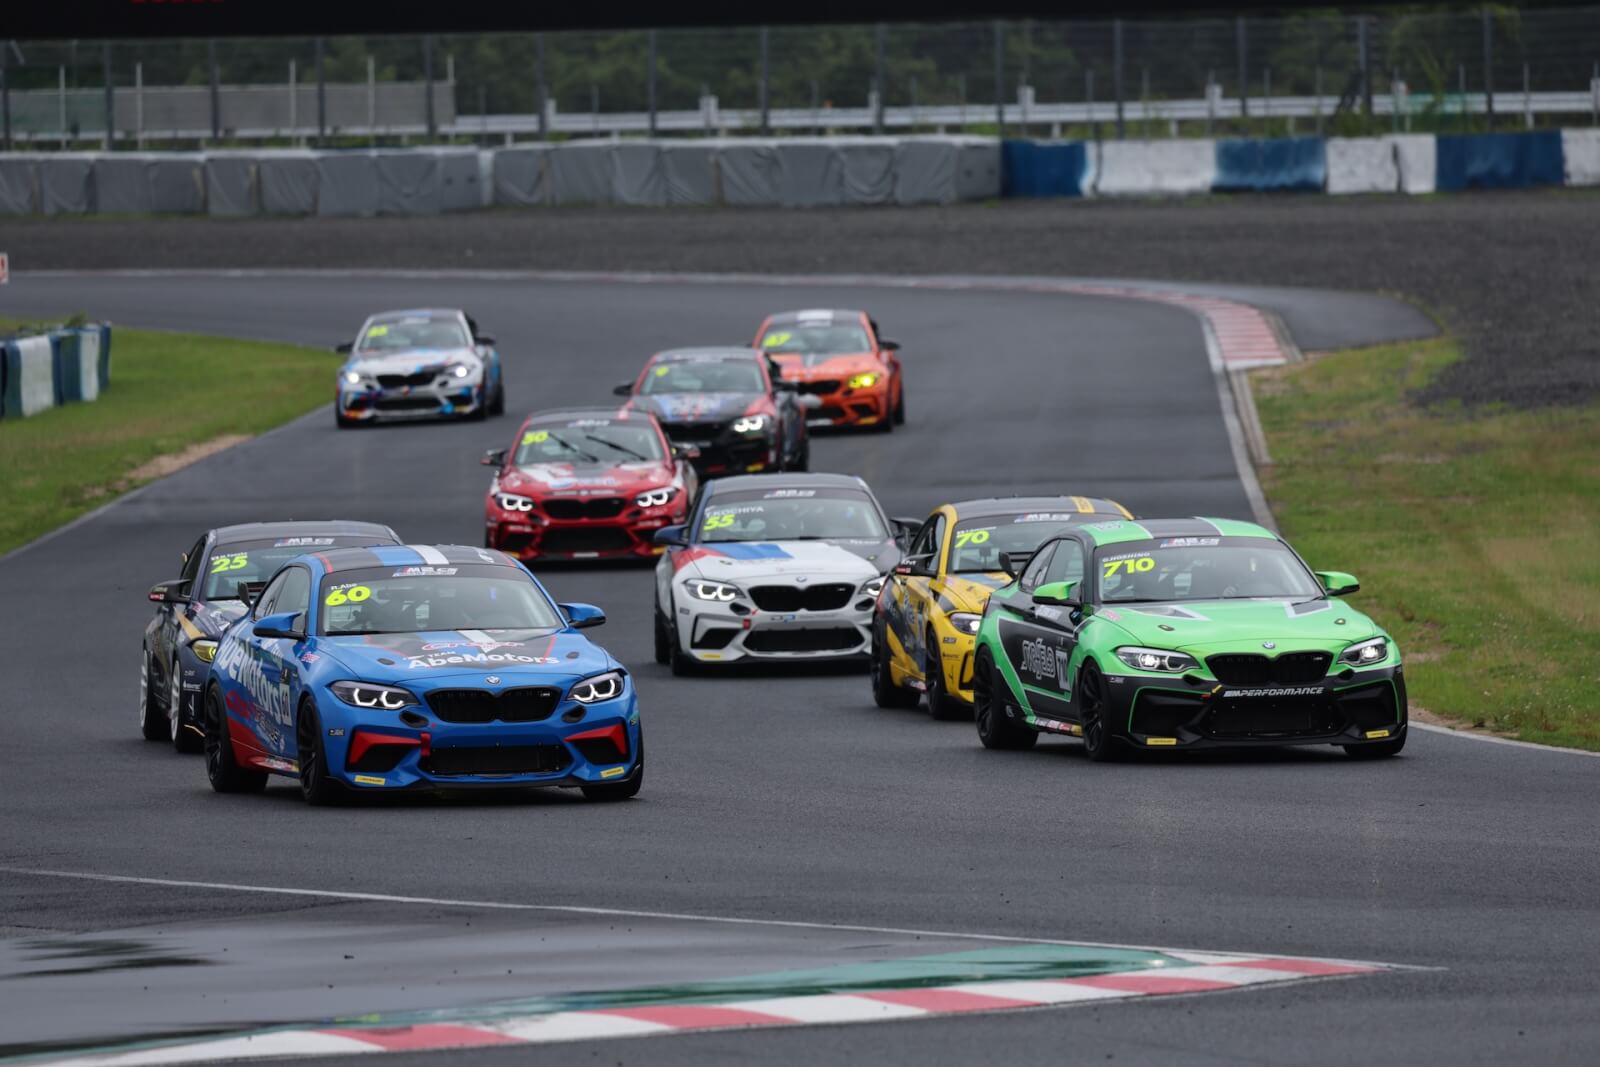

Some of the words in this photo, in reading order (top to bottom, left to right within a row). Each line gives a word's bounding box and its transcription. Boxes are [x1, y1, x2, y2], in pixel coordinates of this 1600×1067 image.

[703, 514, 736, 531] 55
[955, 530, 990, 548] 70
[211, 555, 248, 574] 25
[1103, 557, 1155, 578] 710
[325, 585, 371, 606] 60
[408, 652, 560, 669] AbeMotors
